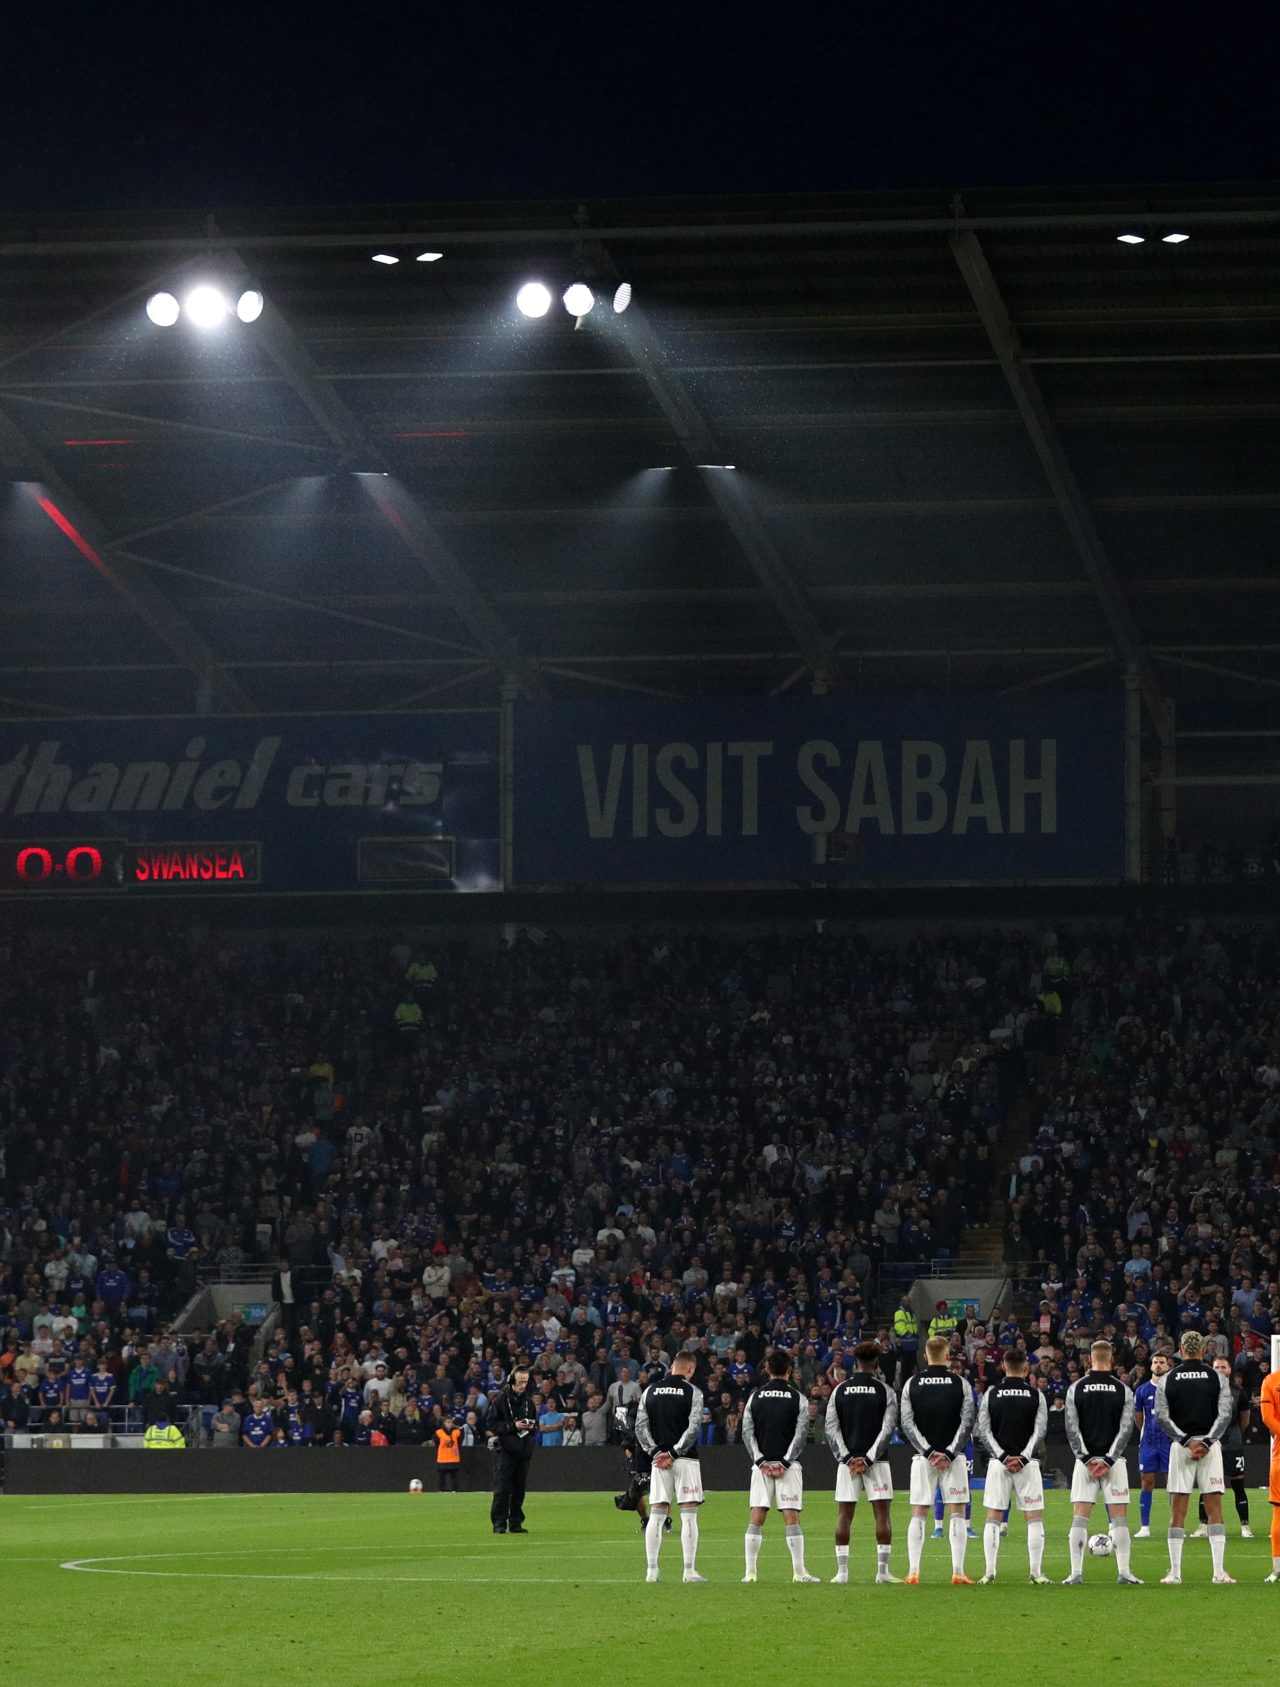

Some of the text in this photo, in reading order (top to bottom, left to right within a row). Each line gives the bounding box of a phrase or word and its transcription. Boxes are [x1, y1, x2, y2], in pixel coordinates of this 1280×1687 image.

[286, 761, 444, 806] cars
[577, 738, 1058, 838] VISIT SABAH
[135, 849, 245, 880] SWANSEA
[251, 1308, 267, 1317] 104
[963, 1303, 979, 1312] 15
[1235, 1457, 1245, 1468] 21
